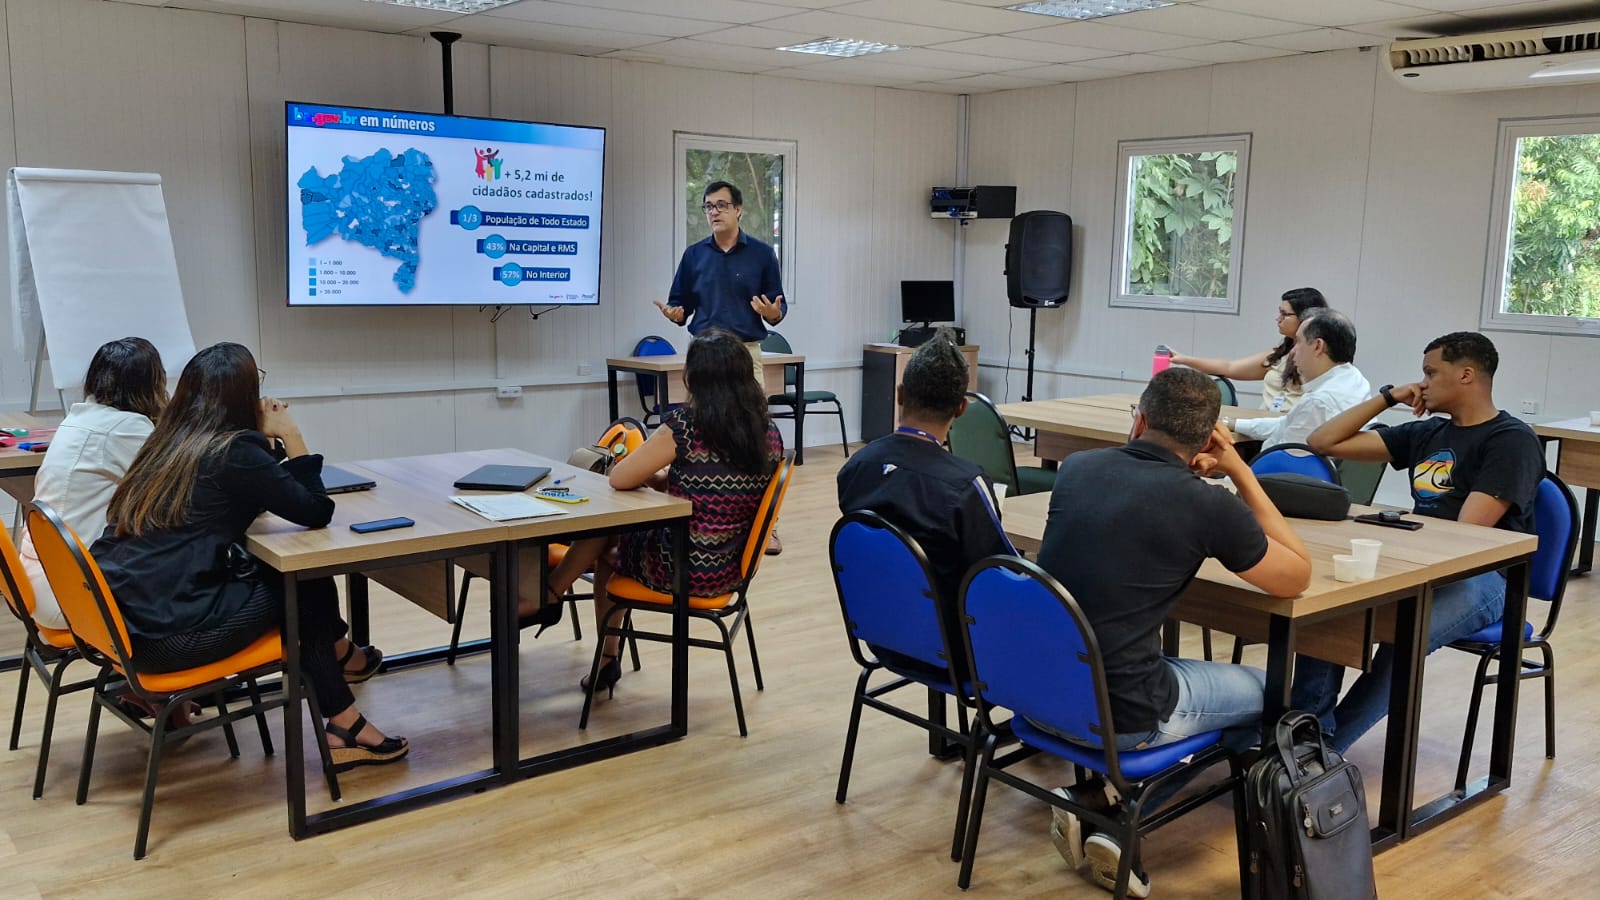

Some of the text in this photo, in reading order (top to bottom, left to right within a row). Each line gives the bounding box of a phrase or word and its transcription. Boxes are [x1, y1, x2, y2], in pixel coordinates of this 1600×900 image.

[360, 115, 379, 127] em
[382, 115, 436, 131] números
[514, 169, 531, 182] 5,2
[534, 171, 548, 182] mi
[551, 171, 565, 182] de
[472, 185, 593, 201] cidadãos cadastrados!
[462, 213, 587, 227] 1/3 População de Todo Estado
[486, 242, 504, 250] 43%
[509, 243, 521, 251] Na
[522, 243, 550, 253] Capital
[558, 244, 576, 253] RMS
[502, 270, 569, 279] 57% No Interior
